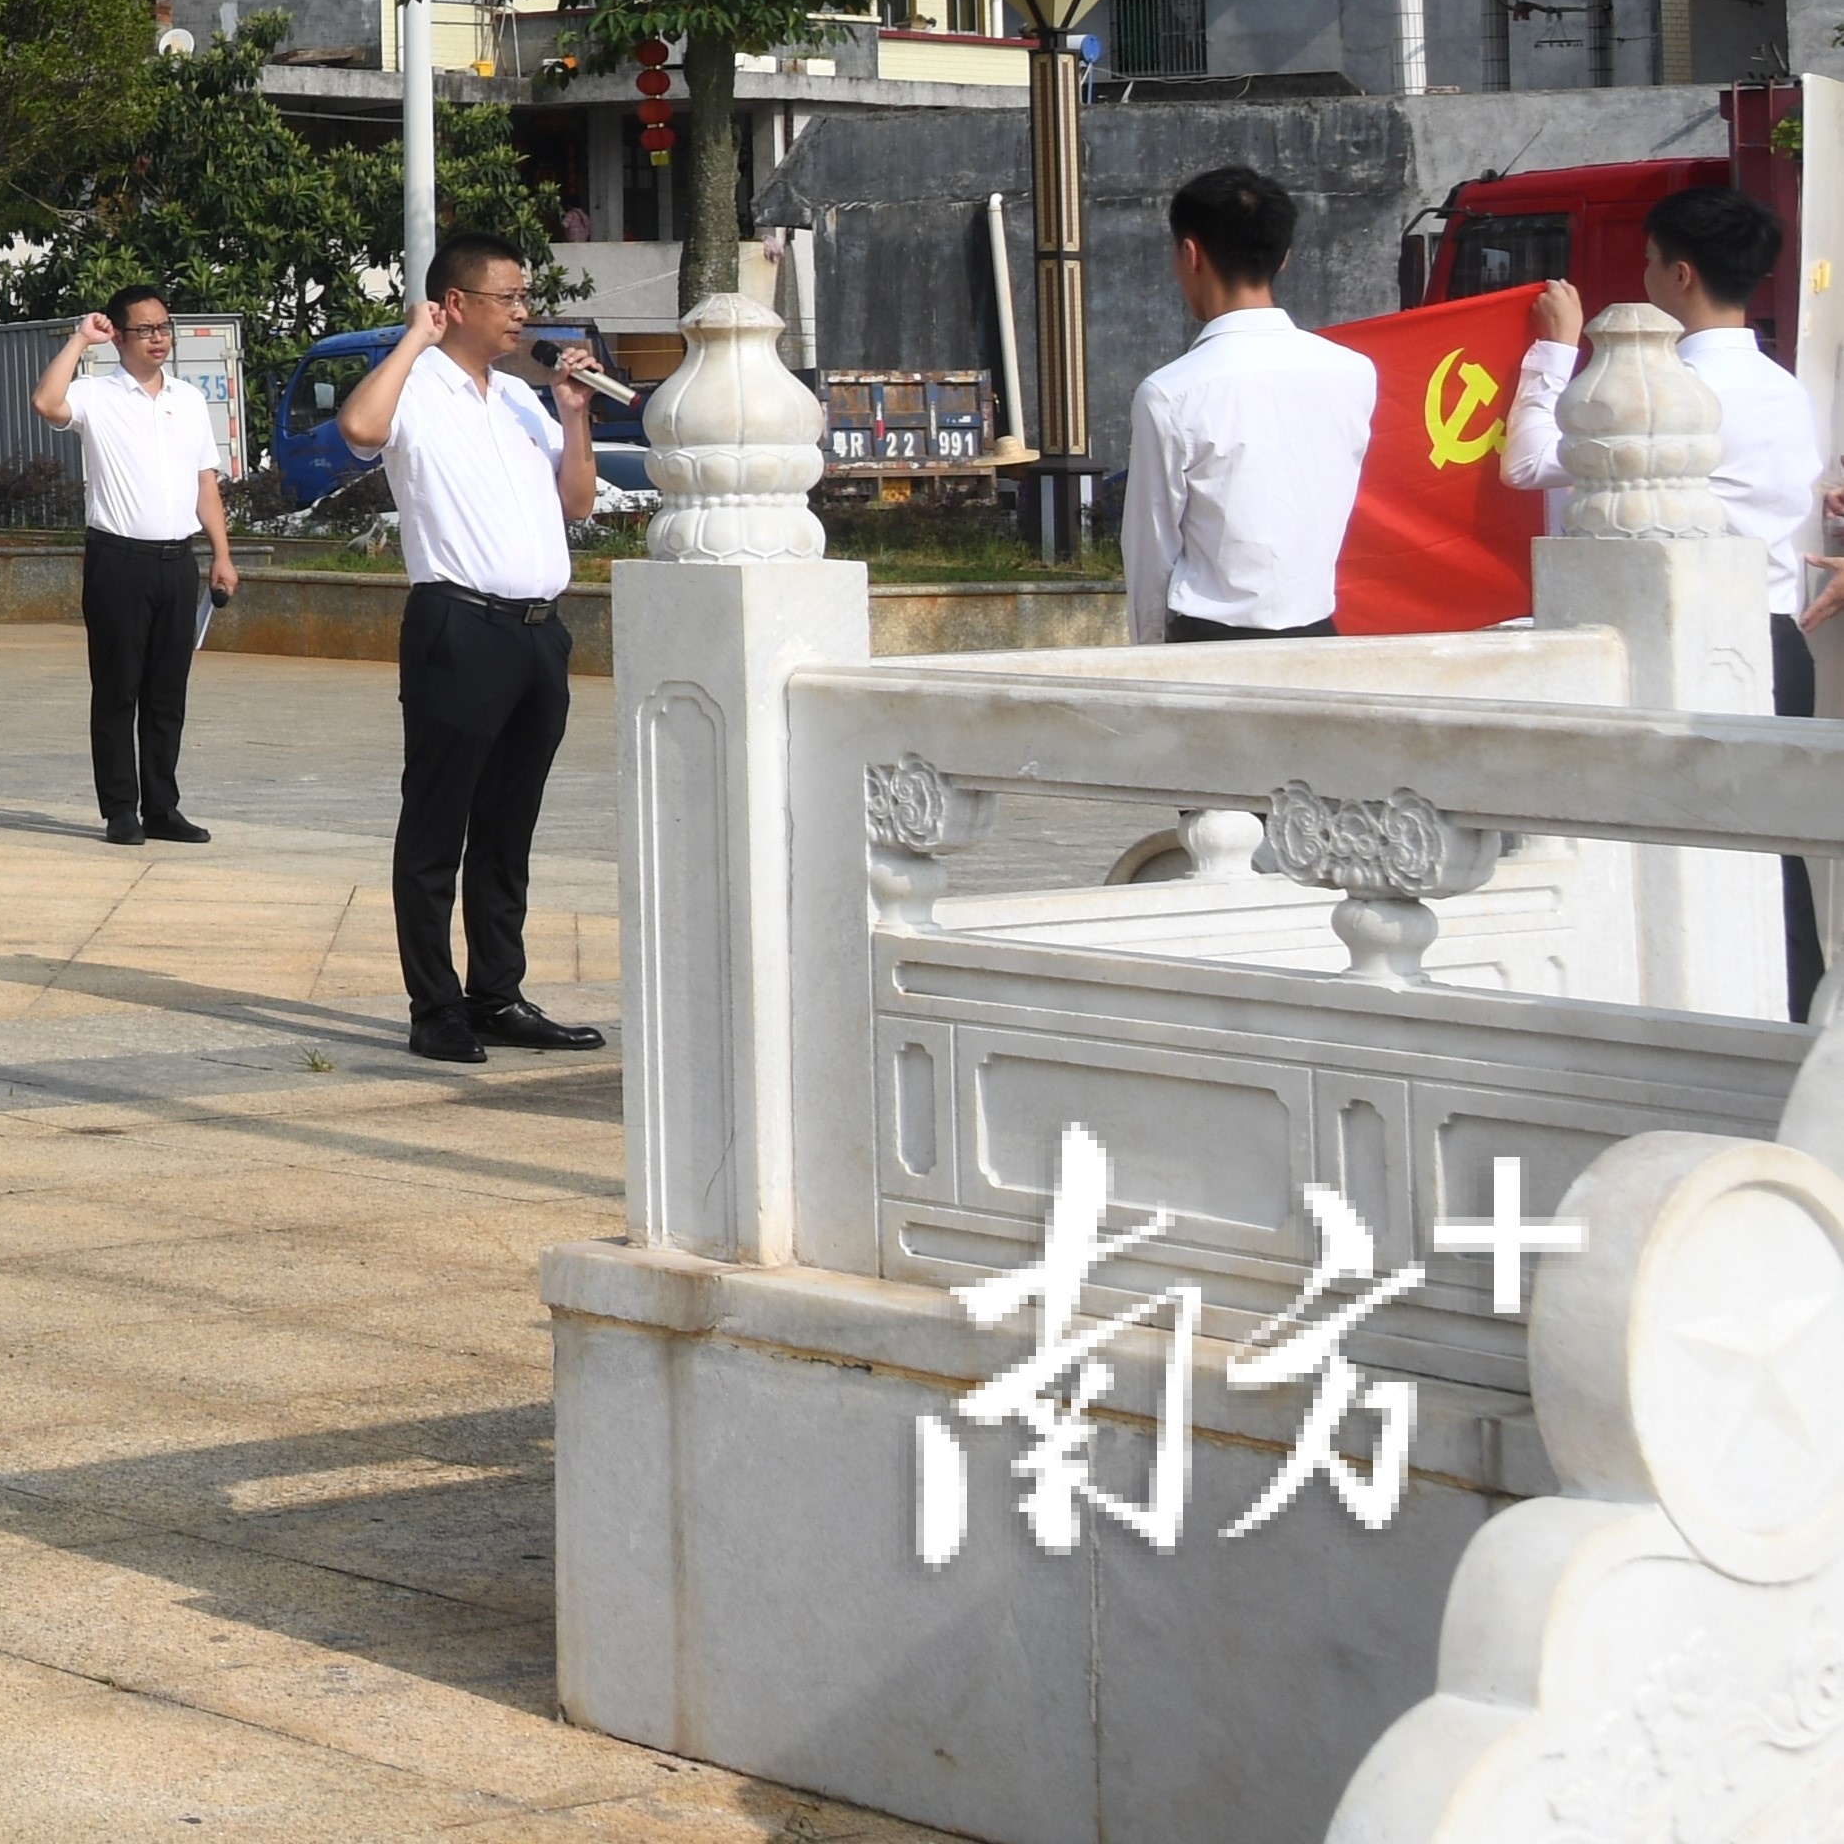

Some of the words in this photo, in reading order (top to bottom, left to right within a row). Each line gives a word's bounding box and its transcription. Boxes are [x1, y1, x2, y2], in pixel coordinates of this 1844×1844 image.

[832, 431, 865, 458] 粤R
[885, 431, 916, 458] 22
[938, 431, 974, 457] 991
